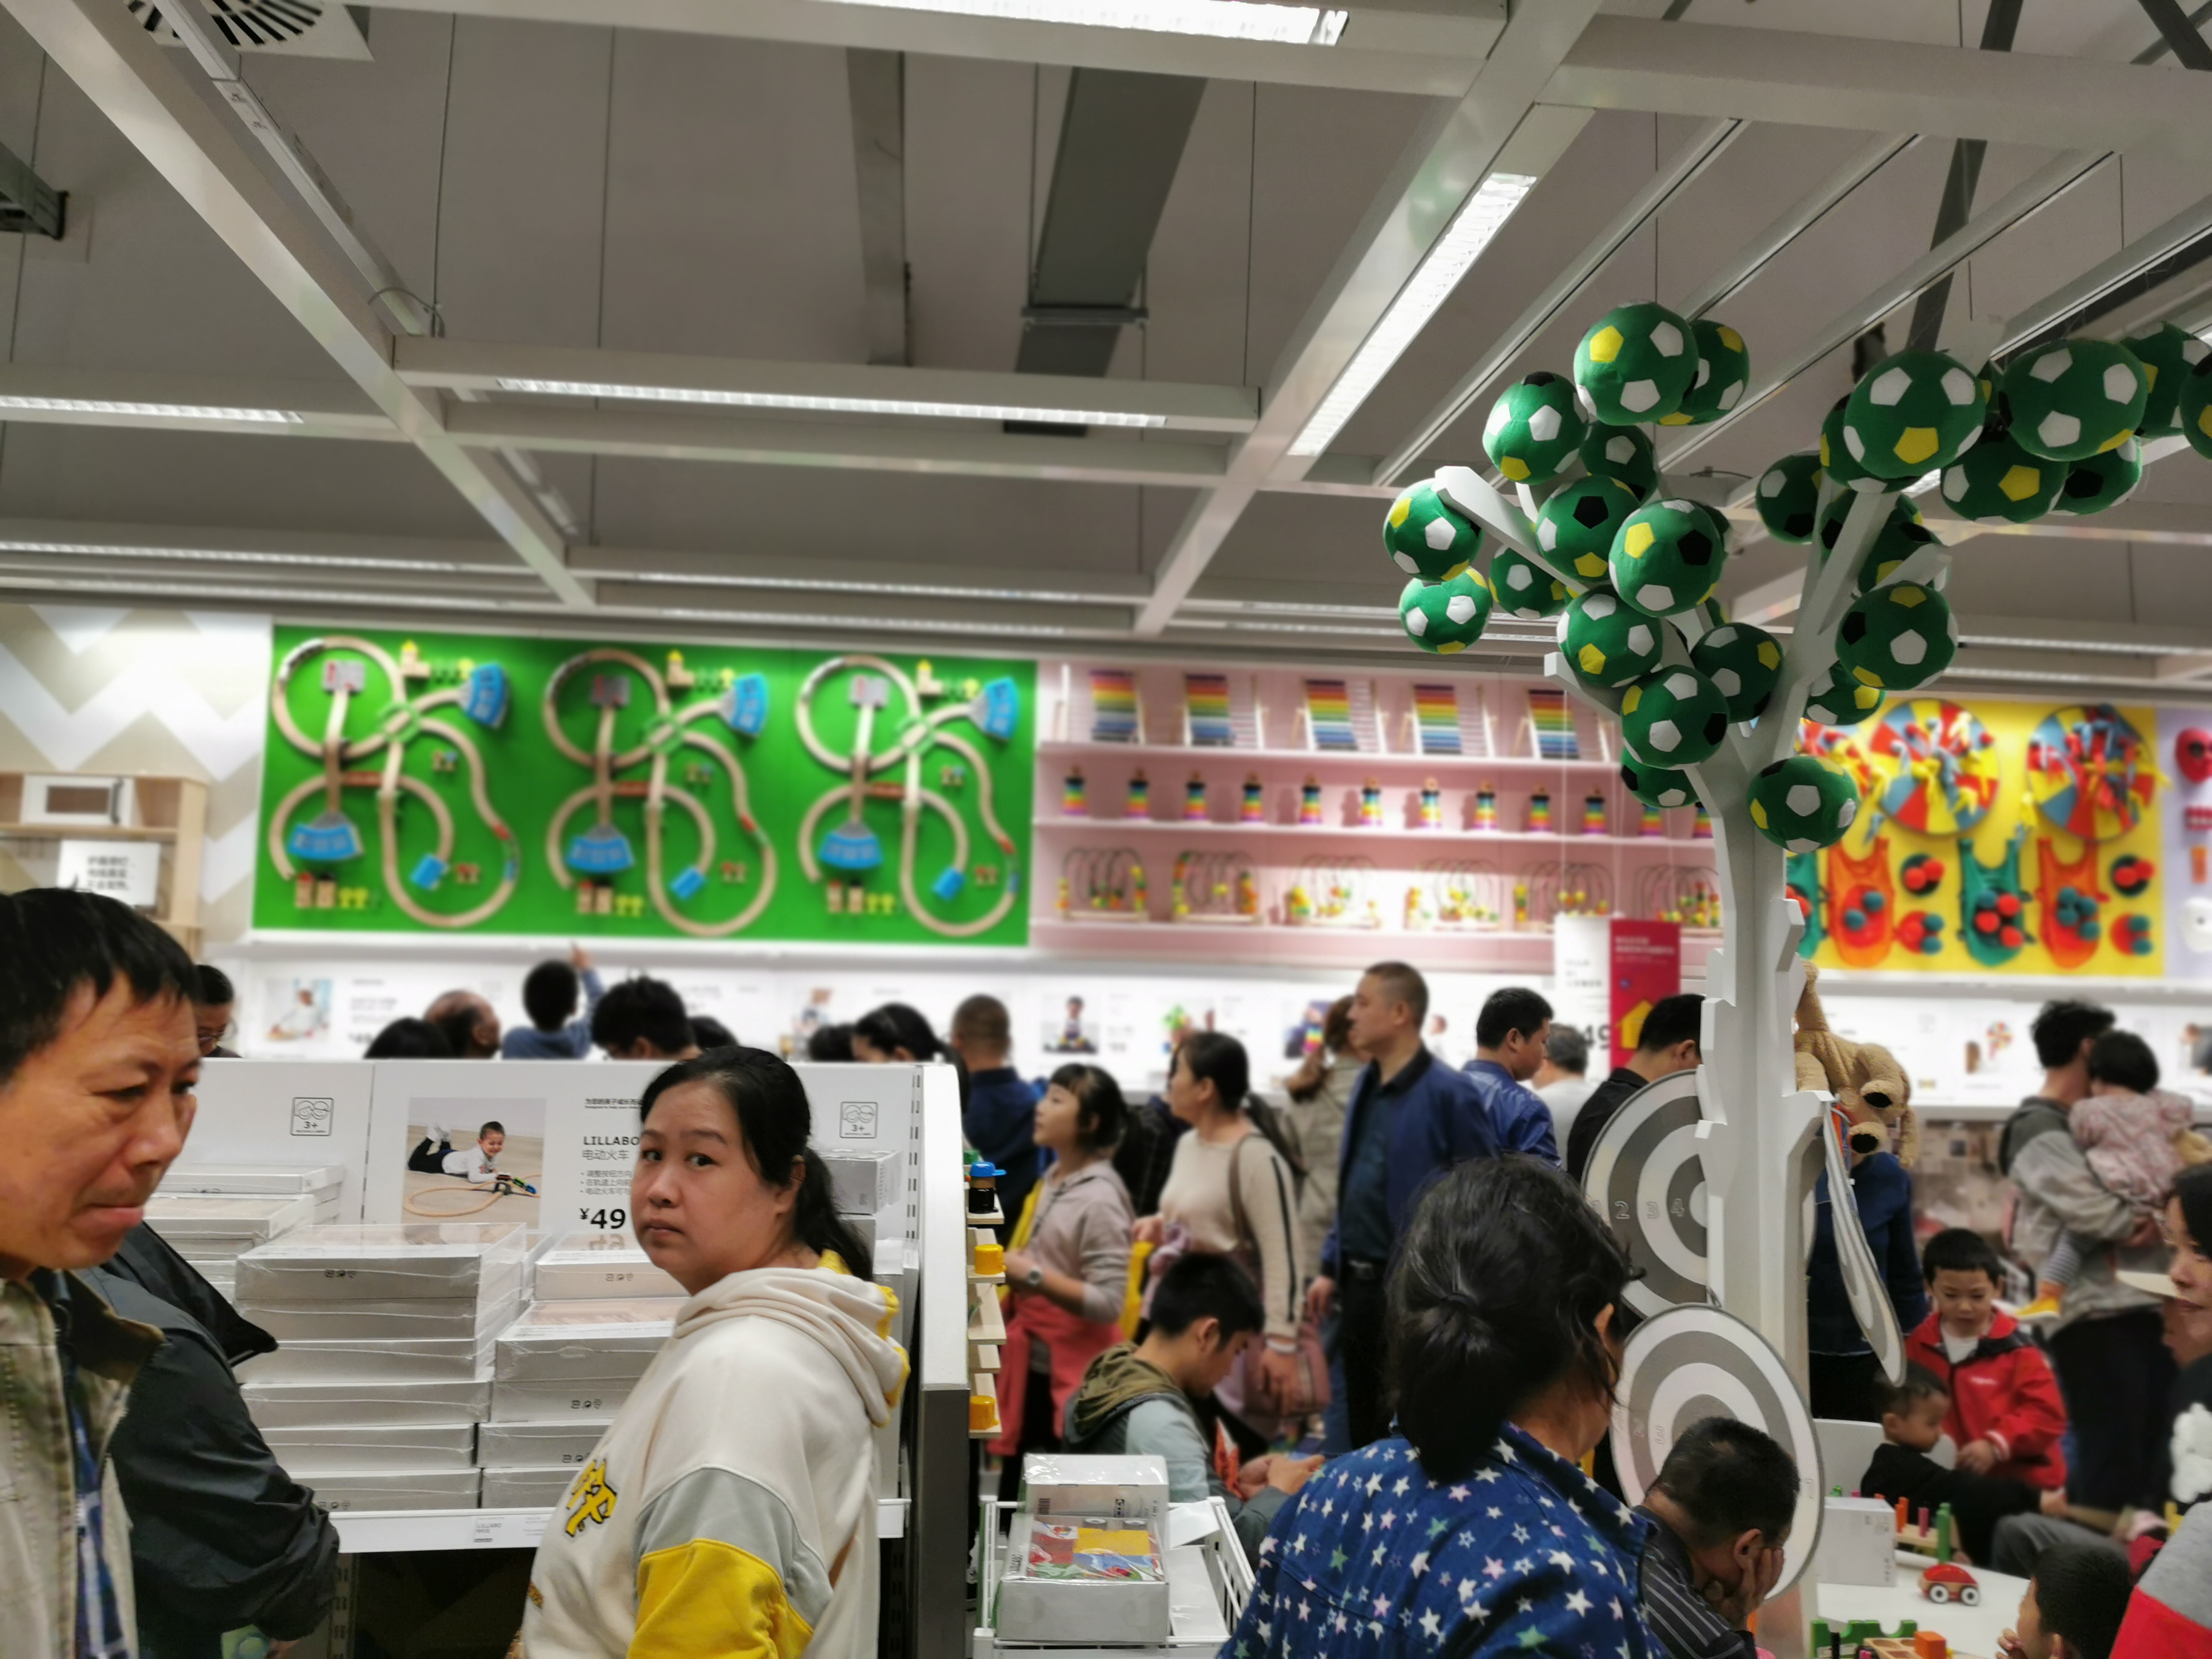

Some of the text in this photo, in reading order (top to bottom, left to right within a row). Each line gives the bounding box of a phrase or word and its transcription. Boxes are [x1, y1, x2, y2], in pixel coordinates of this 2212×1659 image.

[583, 1136, 640, 1145] LILLABO
[582, 1148, 629, 1161] 电动火车
[1614, 1201, 1631, 1219] 2
[1646, 1201, 1659, 1219] 3
[1671, 1198, 1684, 1217] 4
